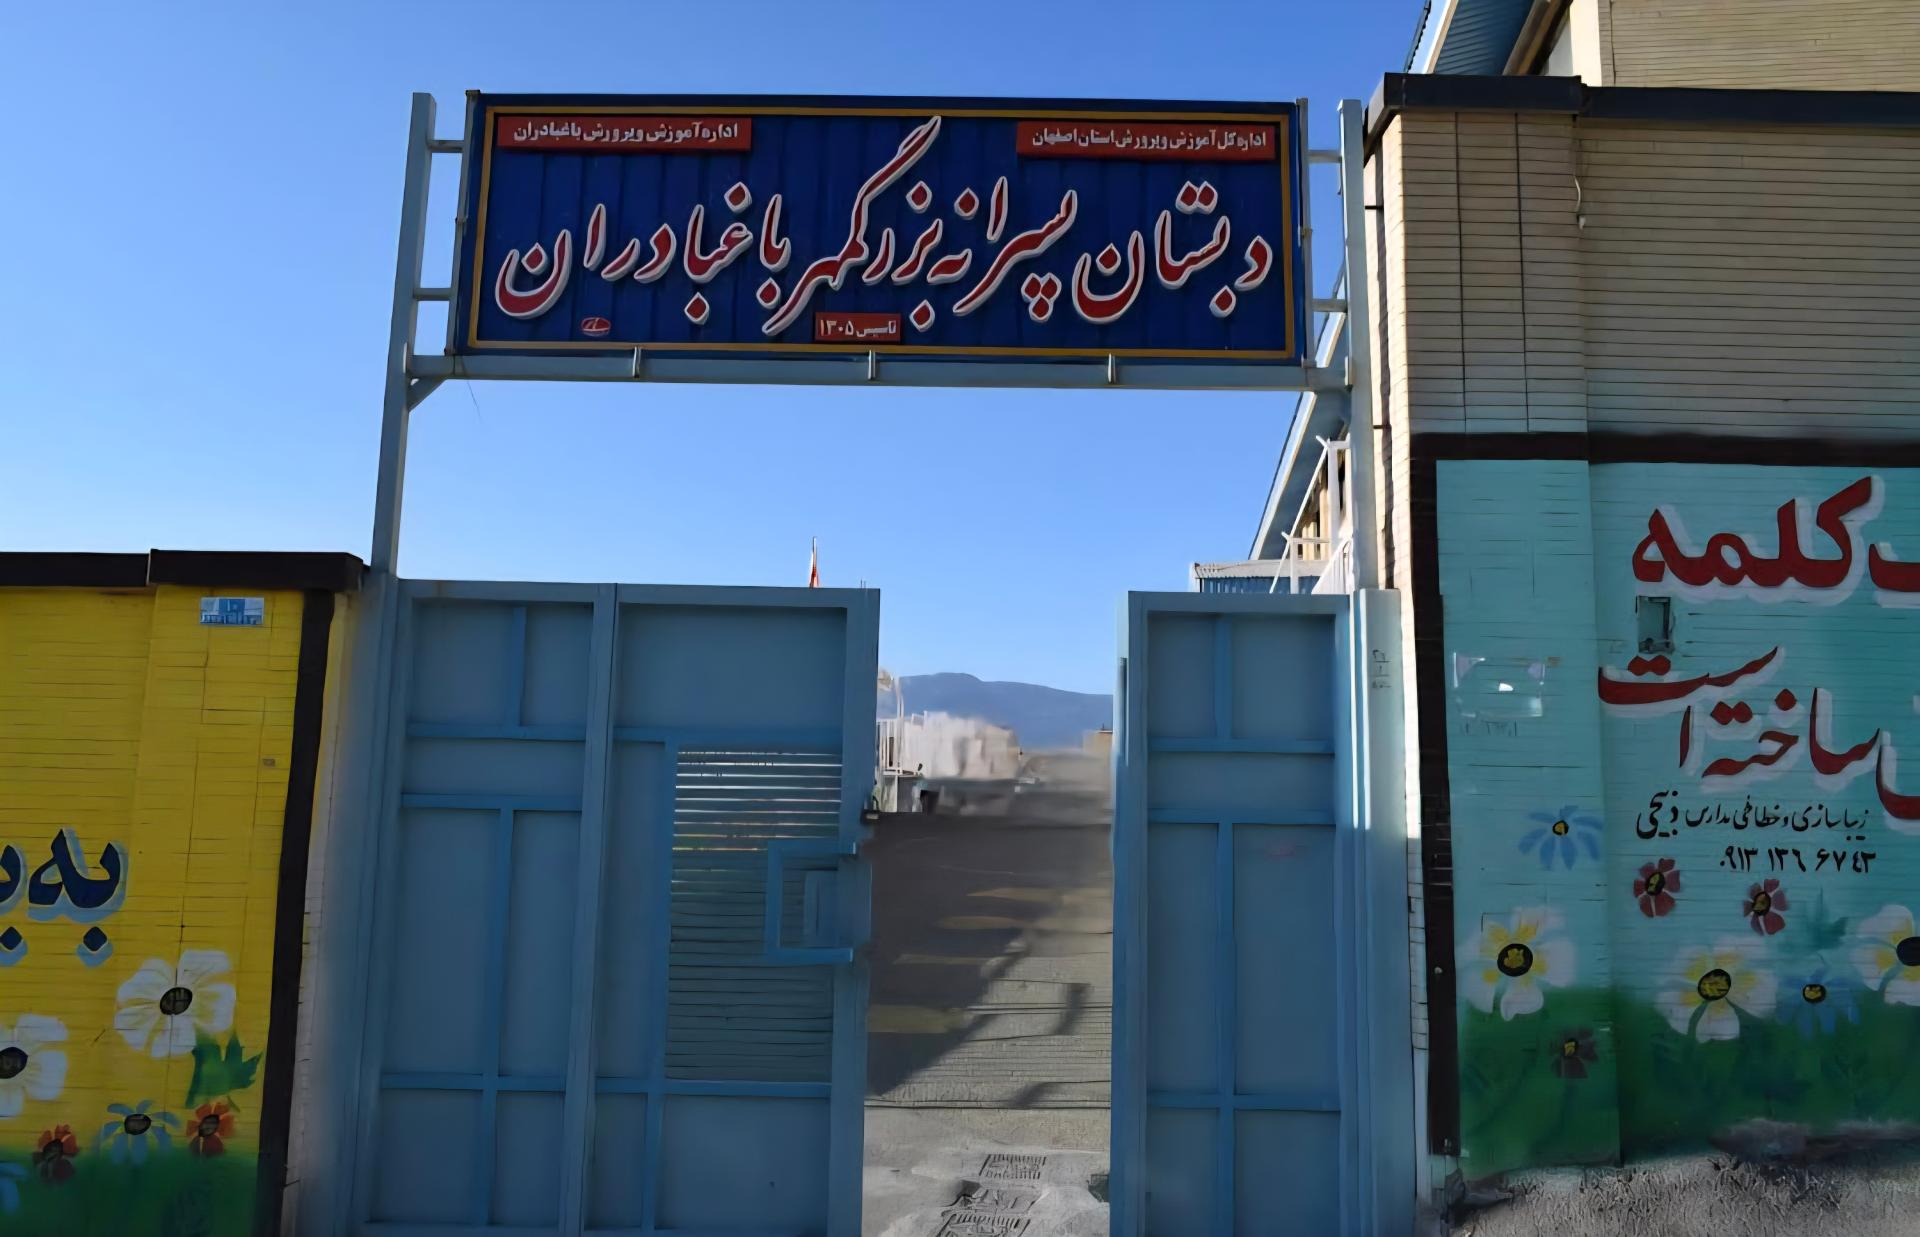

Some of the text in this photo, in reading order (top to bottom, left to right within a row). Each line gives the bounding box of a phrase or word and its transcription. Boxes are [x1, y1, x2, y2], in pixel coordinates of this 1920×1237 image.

[513, 121, 581, 142] باغبادران
[646, 120, 702, 143] آموزش
[702, 122, 739, 143] اداره
[1032, 127, 1078, 146] اصفهان
[1078, 128, 1115, 147] استان
[1170, 129, 1217, 150] آموزش
[1217, 131, 1237, 150] کل
[1237, 131, 1267, 151] اداره
[495, 115, 1273, 336] دبستان پسرانه بزرگمهر باغبادران
[1632, 474, 1878, 596] کلمه
[1685, 803, 1731, 828] مدارس
[27, 826, 127, 960] به
